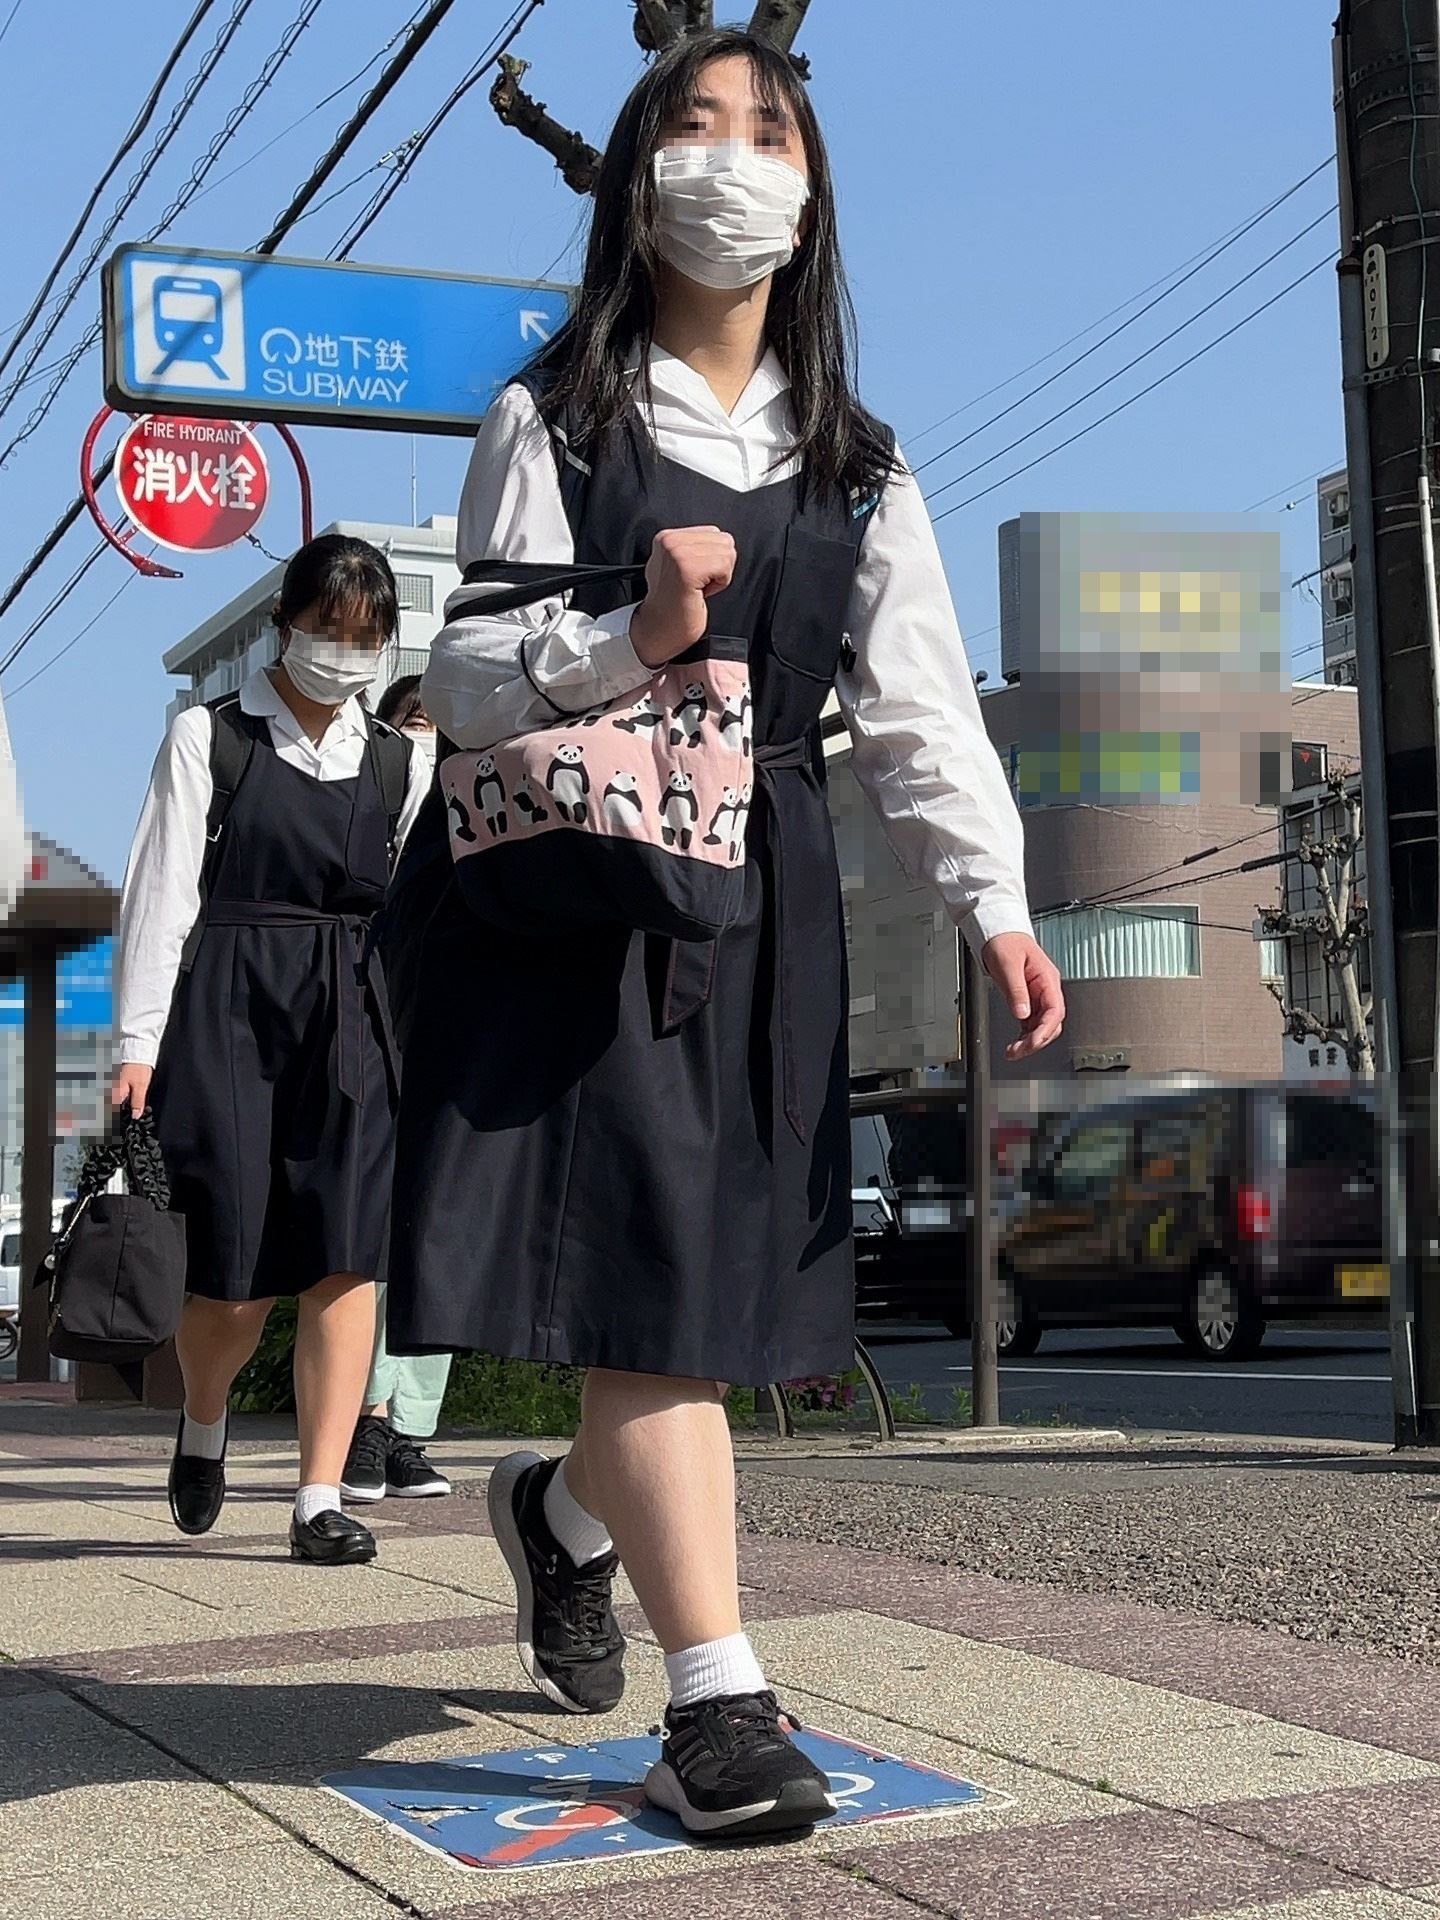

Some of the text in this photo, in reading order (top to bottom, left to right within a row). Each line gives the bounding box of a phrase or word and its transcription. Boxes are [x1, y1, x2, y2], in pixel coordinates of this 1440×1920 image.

[304, 332, 409, 374] 地下鉄
[262, 367, 409, 403] SUBWAY
[144, 421, 242, 446] FIRE HYDRANT
[132, 445, 257, 511] 消火栓
